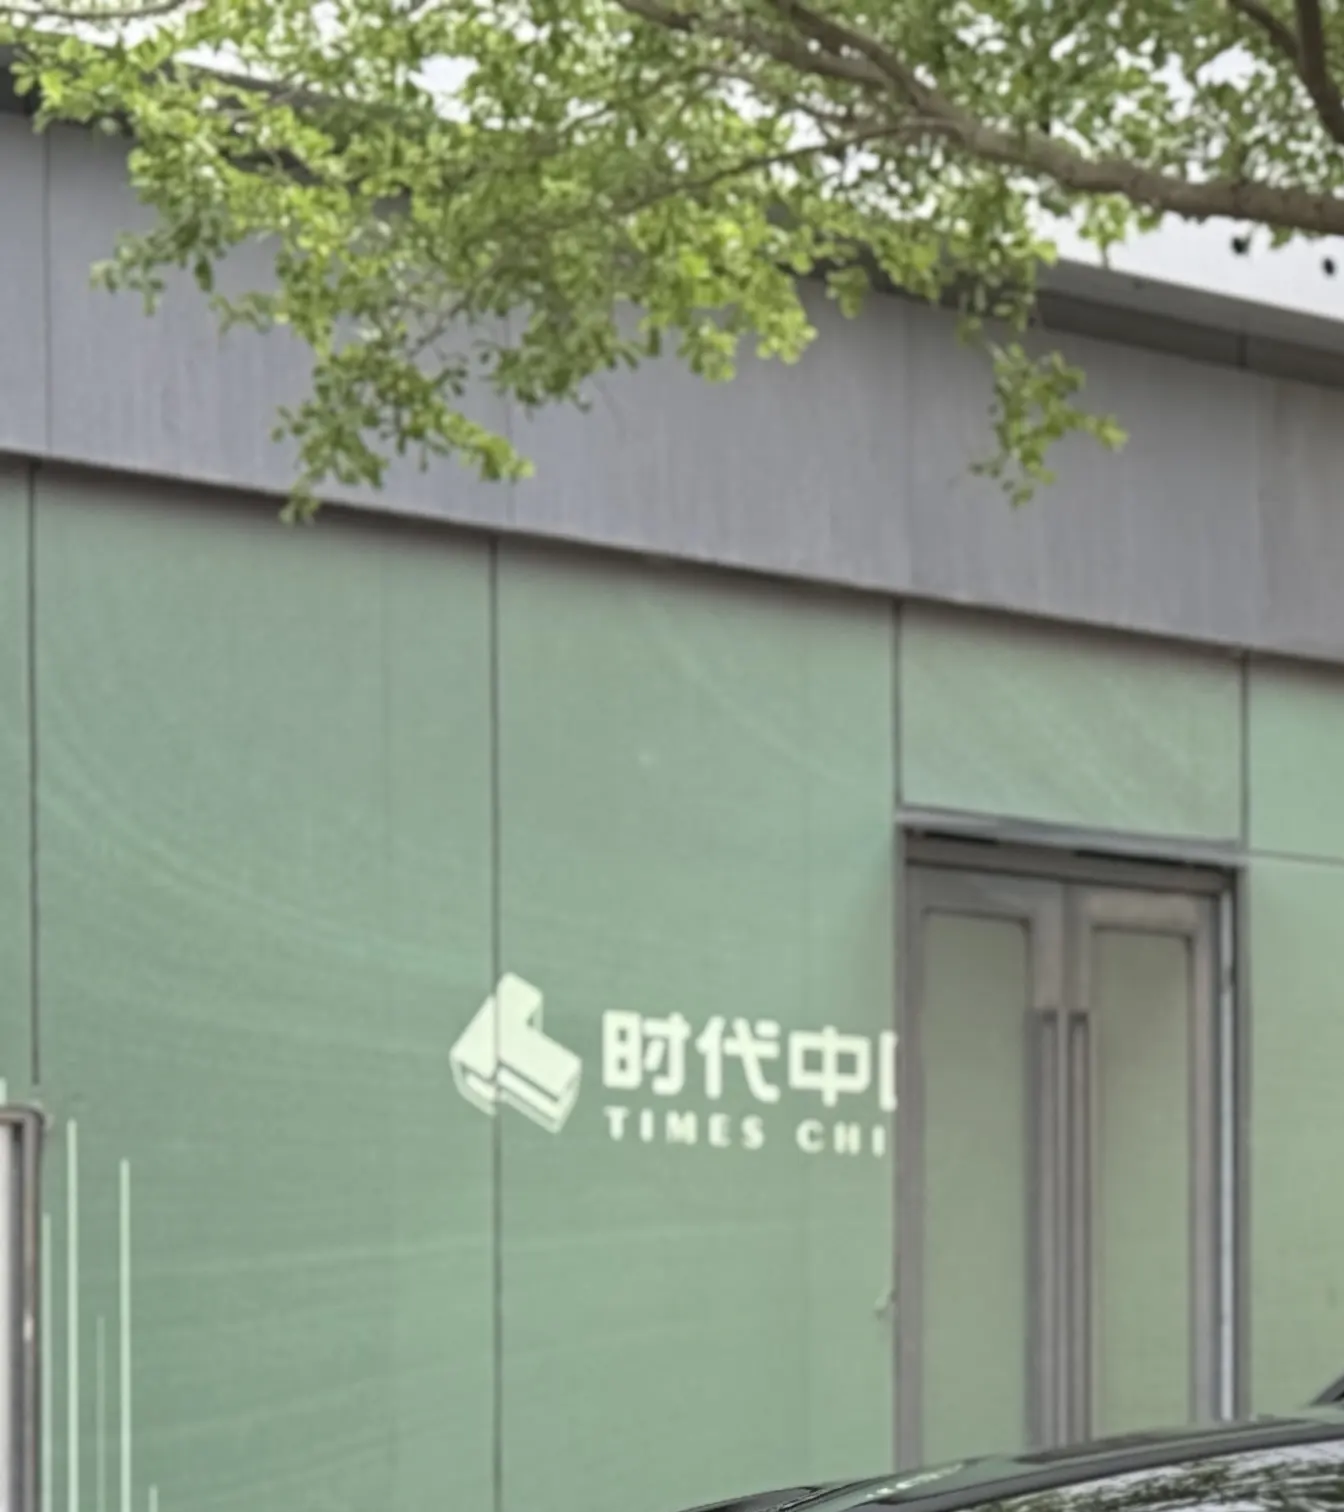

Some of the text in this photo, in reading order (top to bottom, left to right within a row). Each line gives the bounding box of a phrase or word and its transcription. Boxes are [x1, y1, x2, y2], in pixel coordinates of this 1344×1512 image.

[602, 1008, 899, 1112] 时代中
[603, 1105, 765, 1150] TIMES
